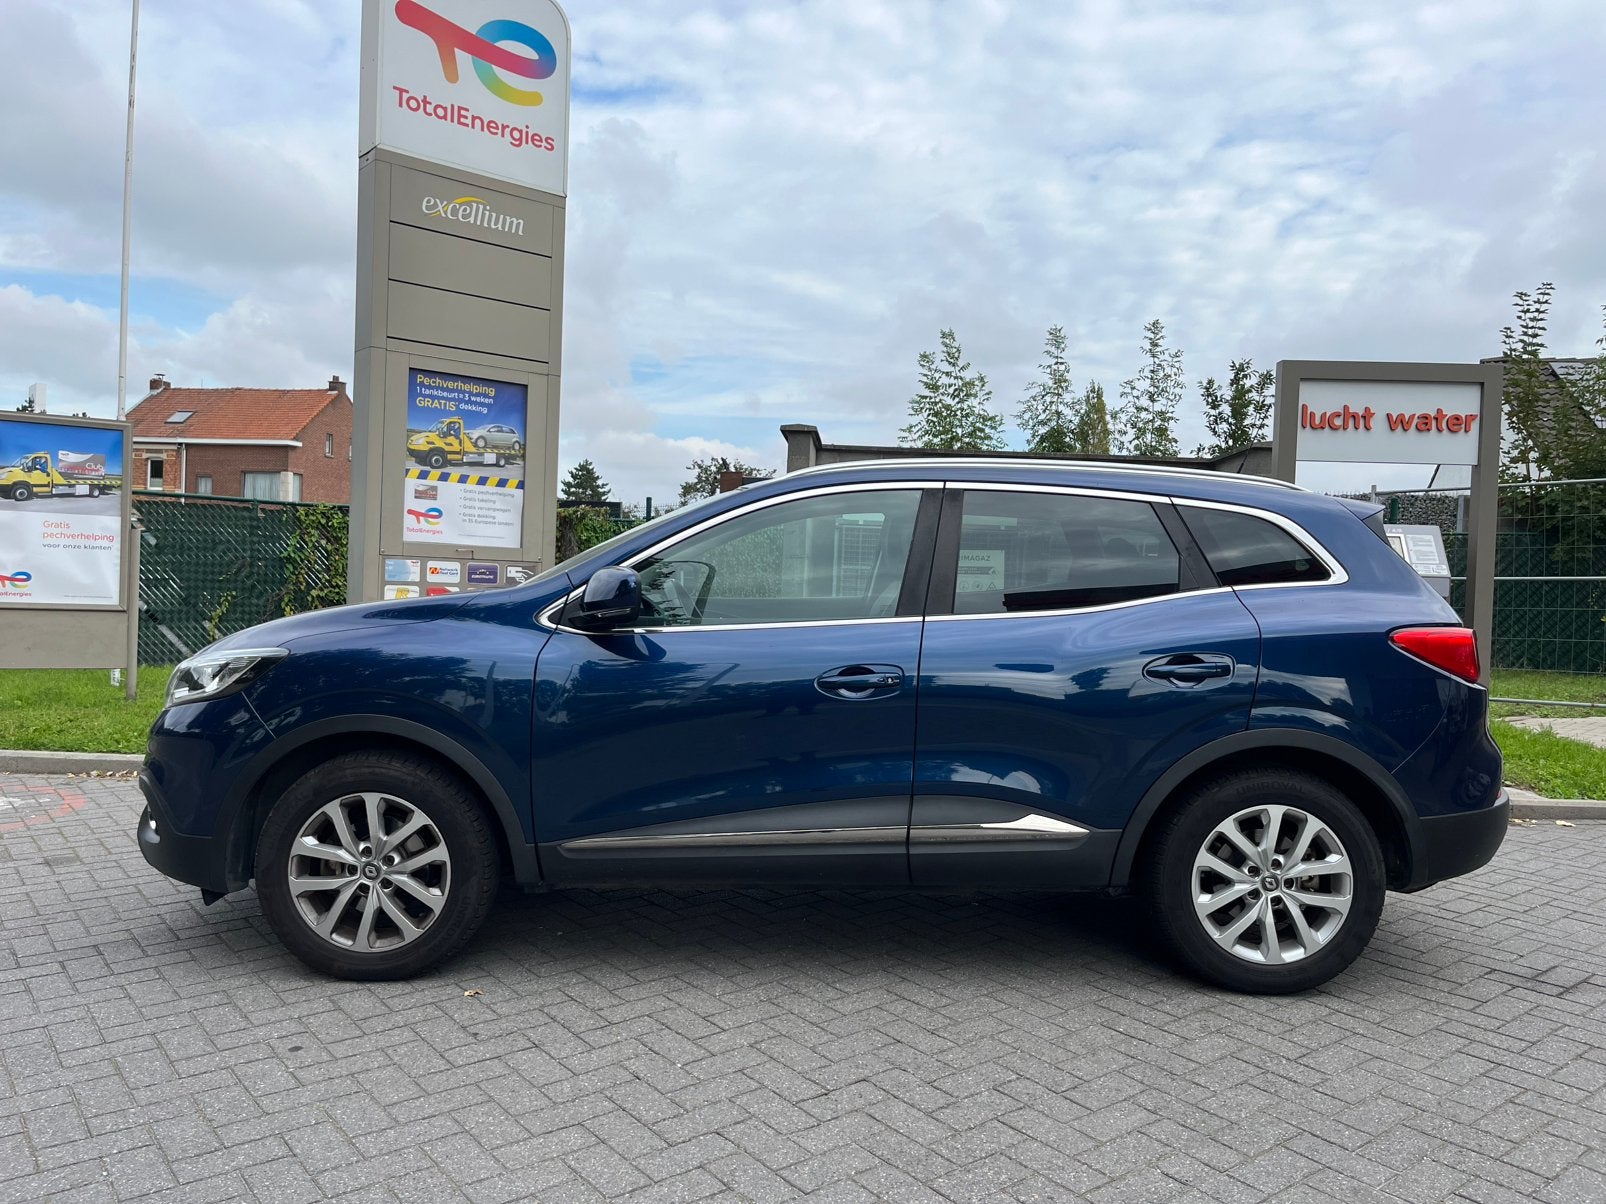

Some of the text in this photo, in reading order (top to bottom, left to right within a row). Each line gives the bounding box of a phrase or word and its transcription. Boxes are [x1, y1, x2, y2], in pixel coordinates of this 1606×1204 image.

[391, 85, 555, 152] TotalEnergies
[422, 196, 525, 236] excellium
[416, 374, 496, 397] Pechverhelping
[416, 386, 420, 394] 1
[421, 387, 459, 399] tankbeurt
[464, 393, 470, 401] 3
[470, 395, 494, 405] weken
[459, 402, 488, 414] dekking
[1302, 403, 1479, 433] lucht water
[43, 520, 70, 529] Gratis
[406, 526, 443, 535] TotalEnergies
[42, 531, 115, 542] pechverhelping
